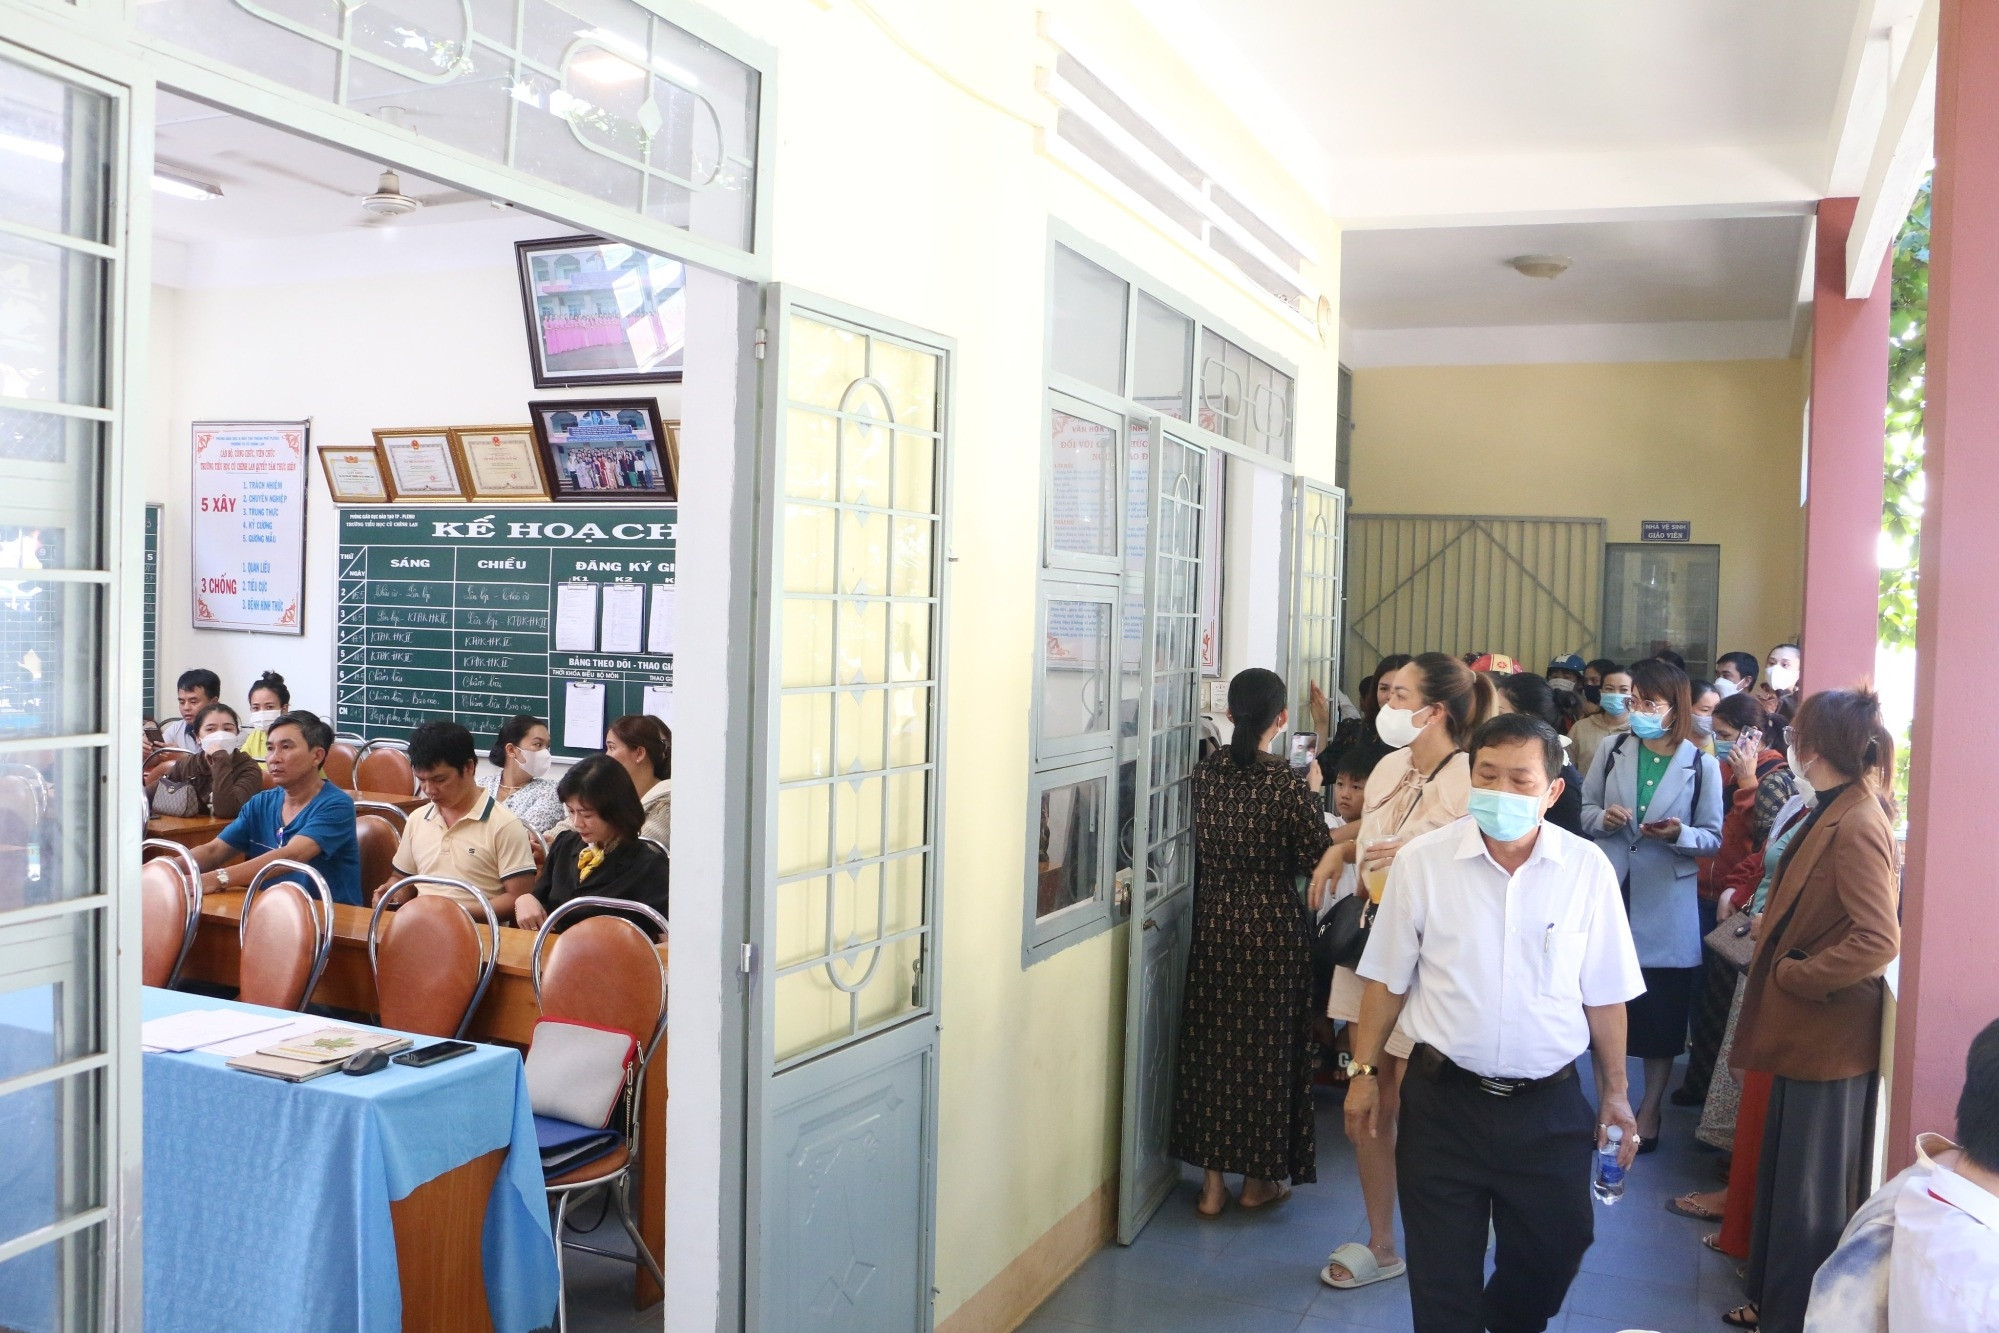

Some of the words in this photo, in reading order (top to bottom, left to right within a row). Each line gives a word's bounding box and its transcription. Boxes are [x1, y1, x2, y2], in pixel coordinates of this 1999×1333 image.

[202, 498, 208, 512] 5
[212, 494, 236, 512] XÂY
[432, 514, 496, 538] KẾ
[507, 522, 676, 543] HOẠCH
[390, 557, 430, 568] SÁNG
[478, 557, 526, 569] CHIỀU
[576, 560, 622, 572] ĐĂNG
[629, 561, 652, 572] KÝ
[202, 578, 206, 593] 3
[209, 572, 237, 594] CHỐNG
[569, 656, 590, 666] BẢNG
[592, 659, 614, 668] THEO
[617, 659, 631, 668] DÕI
